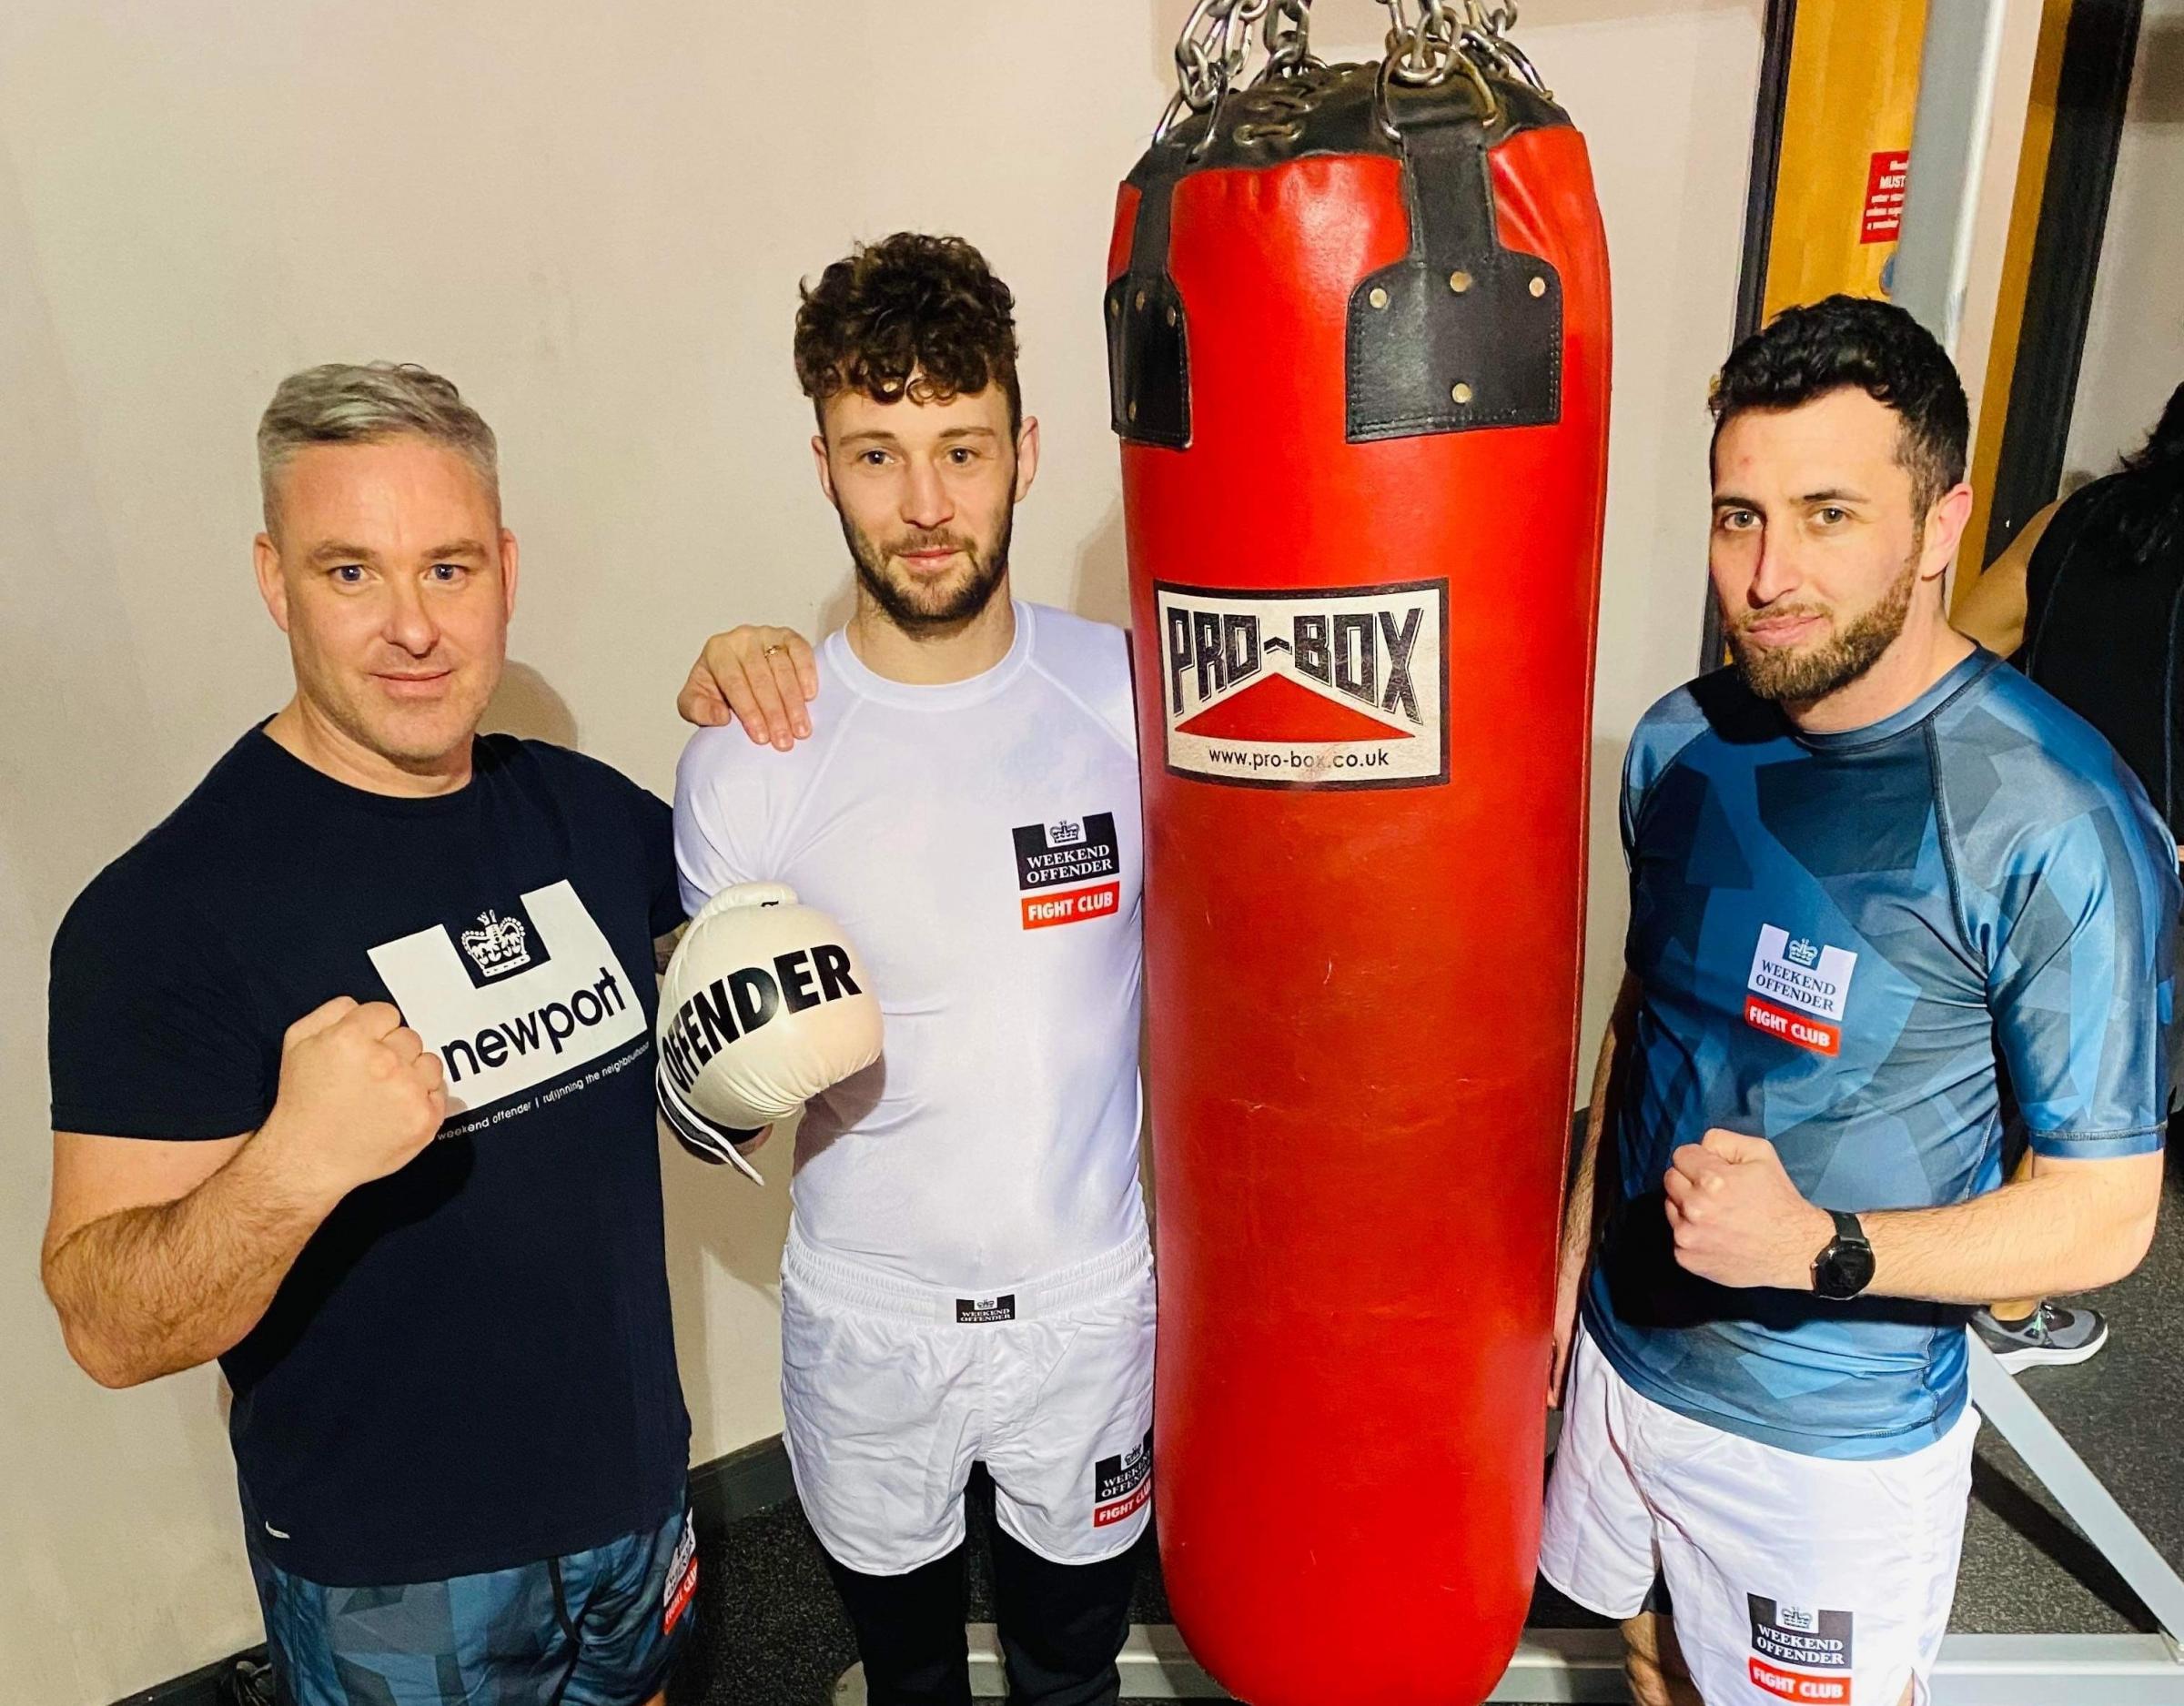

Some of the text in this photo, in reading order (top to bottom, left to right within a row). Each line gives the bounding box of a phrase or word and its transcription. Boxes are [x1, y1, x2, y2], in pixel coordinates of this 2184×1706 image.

[1879, 175, 1906, 189] MUST
[1209, 748, 1389, 770] www.pro-box.co.uk
[1026, 844, 1110, 869] WEEKEND
[1026, 858, 1113, 883] OFFENDER
[1027, 891, 1113, 921] FIGHT CLUB
[1762, 959, 1836, 995] WEEKEND
[1755, 974, 1834, 1012] OFFENDER
[440, 966, 627, 1083] newport
[662, 944, 863, 1094] OFFENDER
[1749, 1005, 1831, 1046] FIGHT CLUB
[437, 1117, 490, 1140] weekend
[492, 1102, 531, 1123] offender
[585, 1072, 601, 1085] the
[962, 1308, 1010, 1317] WEEKEND
[1098, 1499, 1135, 1521] FIGHT
[1756, 1636, 1845, 1664] OFFENDER
[1757, 1623, 1844, 1650] WEEKEND
[1753, 1667, 1844, 1699] FIGHT CLUB
